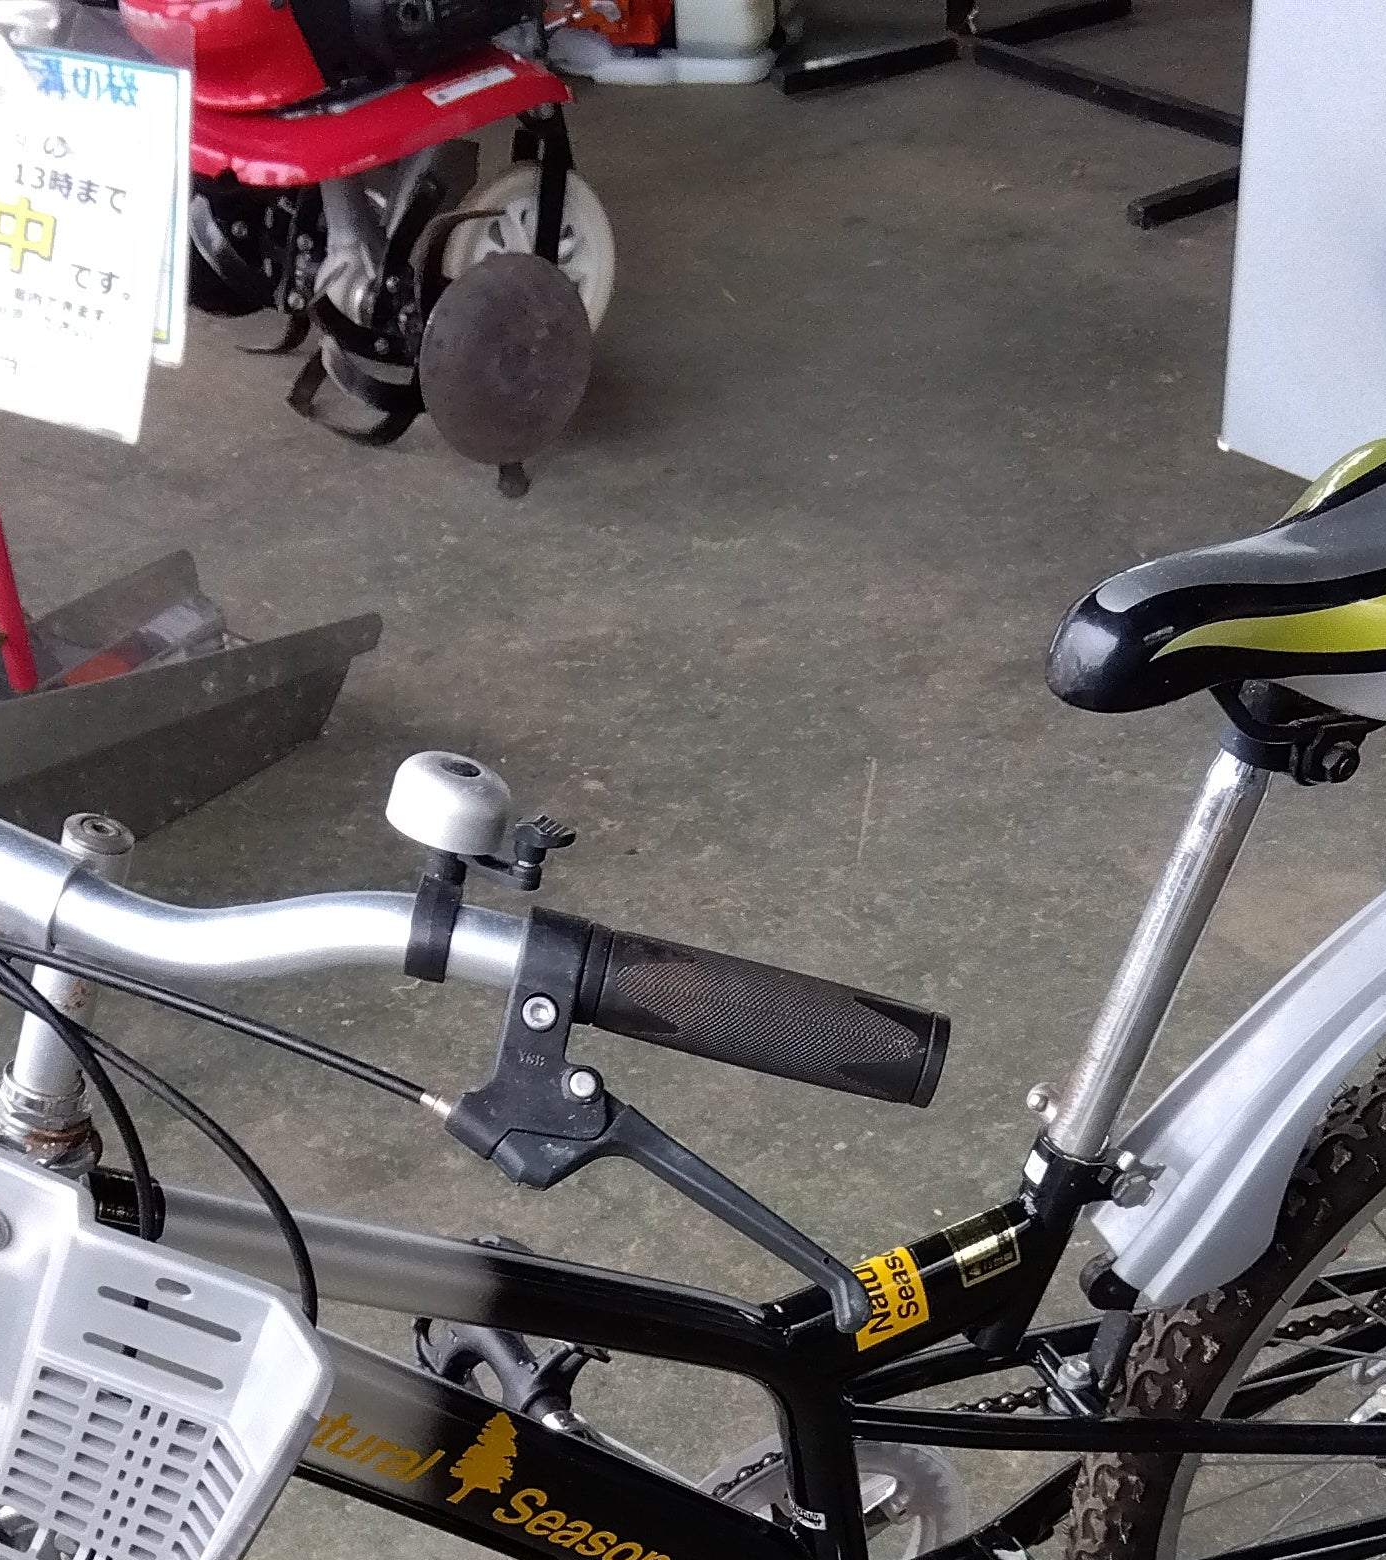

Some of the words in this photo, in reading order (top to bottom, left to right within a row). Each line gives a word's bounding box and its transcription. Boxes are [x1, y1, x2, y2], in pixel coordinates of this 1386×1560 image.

[15, 163, 128, 214] 13時まで
[71, 263, 131, 301] です。
